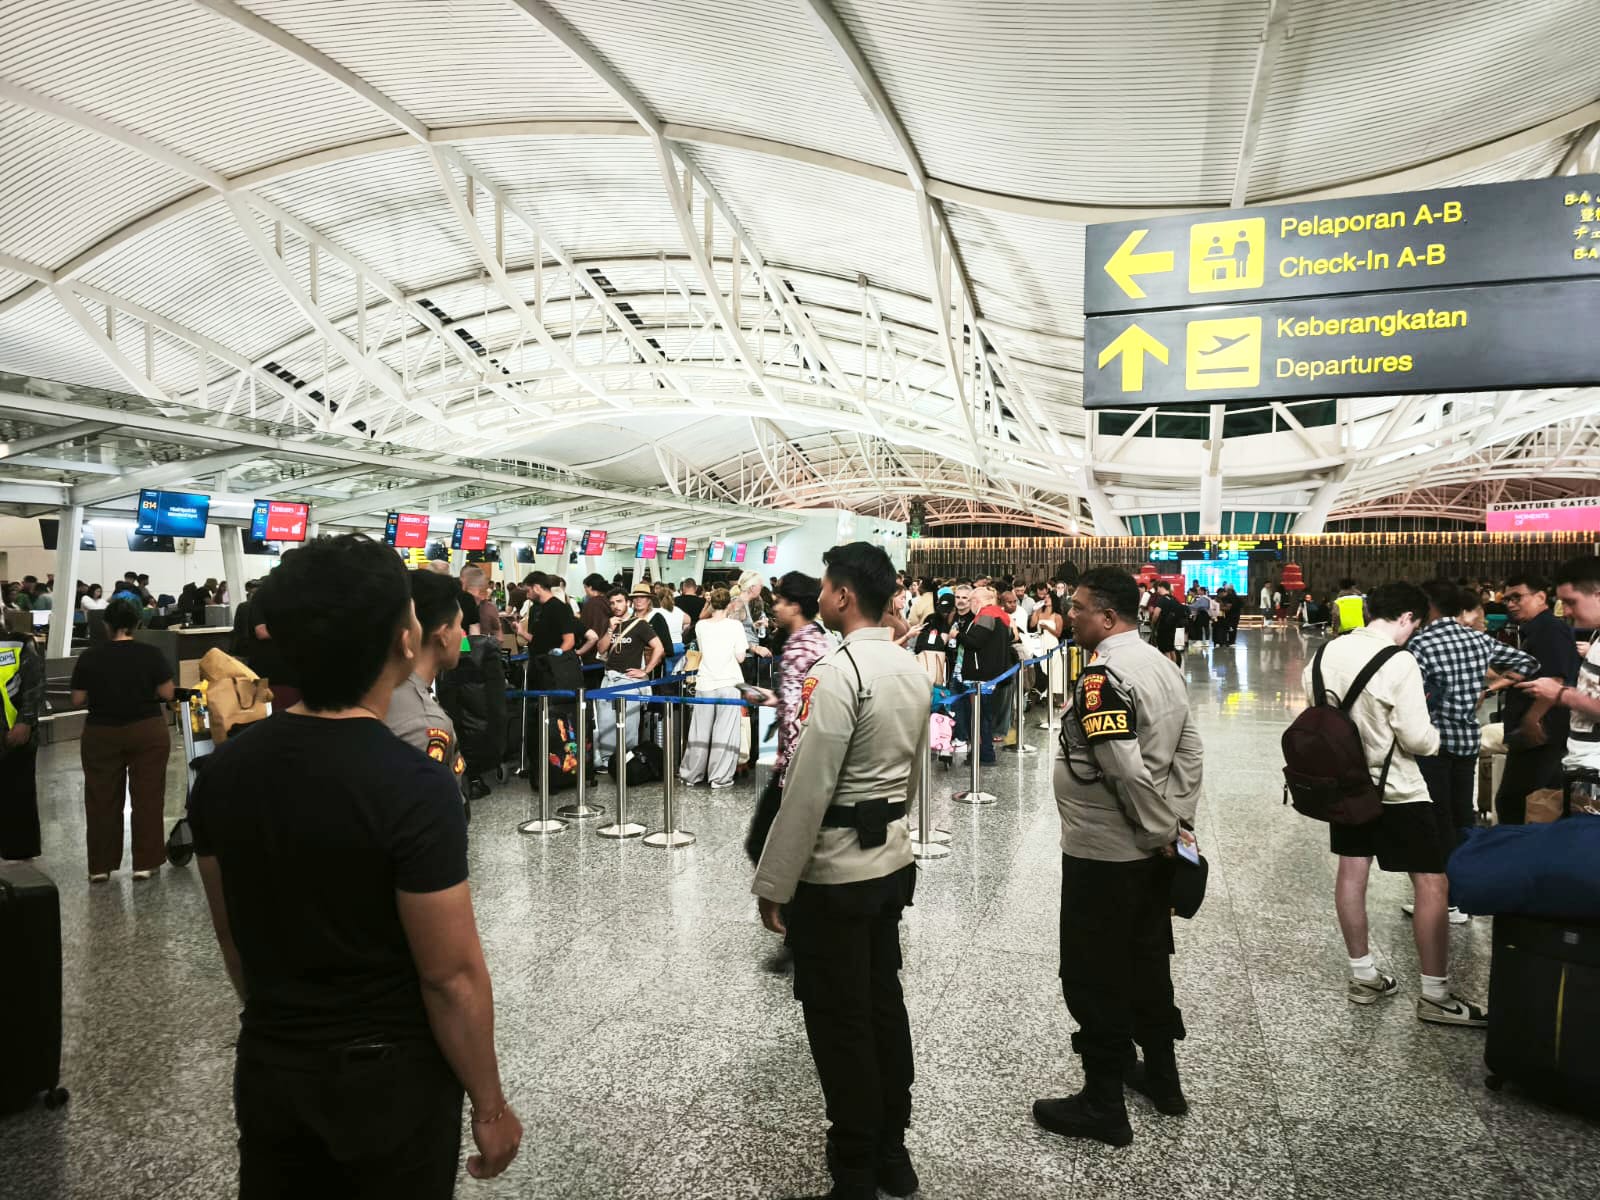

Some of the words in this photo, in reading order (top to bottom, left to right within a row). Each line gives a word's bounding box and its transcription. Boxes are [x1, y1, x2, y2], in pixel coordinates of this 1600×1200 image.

[1280, 210, 1406, 239] Pelaporan
[1413, 201, 1463, 226] A-B
[1279, 249, 1389, 278] Check-In
[1397, 243, 1447, 269] A-B
[1277, 308, 1468, 338] Keberangkatan
[1276, 354, 1414, 380] Departures
[1493, 502, 1556, 511] DEPARTURE
[1560, 499, 1597, 507] GATES
[1083, 714, 1127, 733] AWAS
